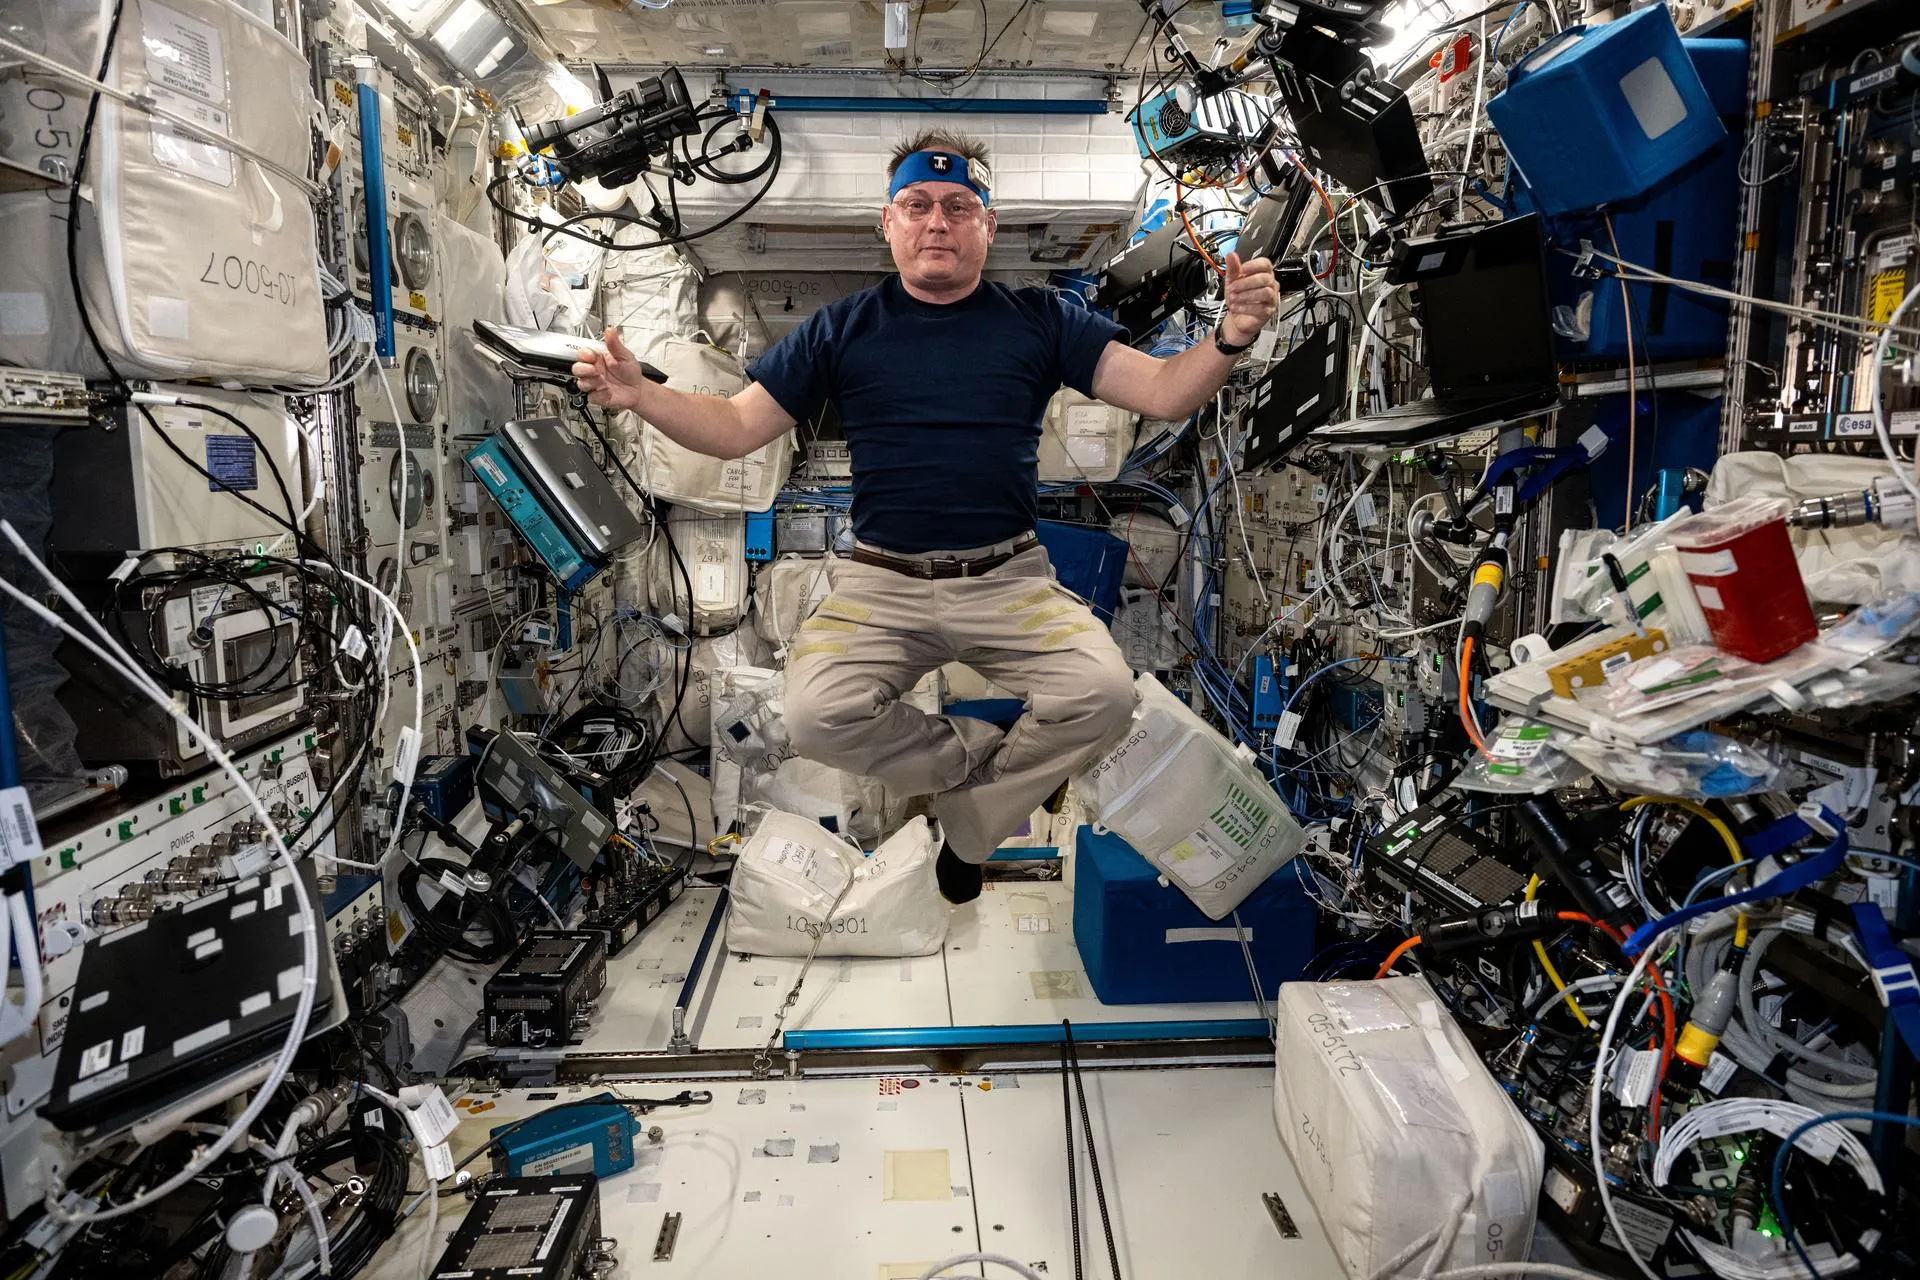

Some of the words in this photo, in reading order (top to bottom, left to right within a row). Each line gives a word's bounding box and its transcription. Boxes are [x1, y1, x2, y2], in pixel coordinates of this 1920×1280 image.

[1344, 3, 1362, 11] Canon
[1859, 74, 1880, 87] Metal
[200, 251, 297, 308] 1.0-5007
[1851, 418, 1872, 430] esa
[286, 770, 308, 789] BUSBOX
[170, 829, 196, 850] POWER
[1214, 825, 1279, 892] 0.5-5456
[52, 1015, 68, 1030] SMO
